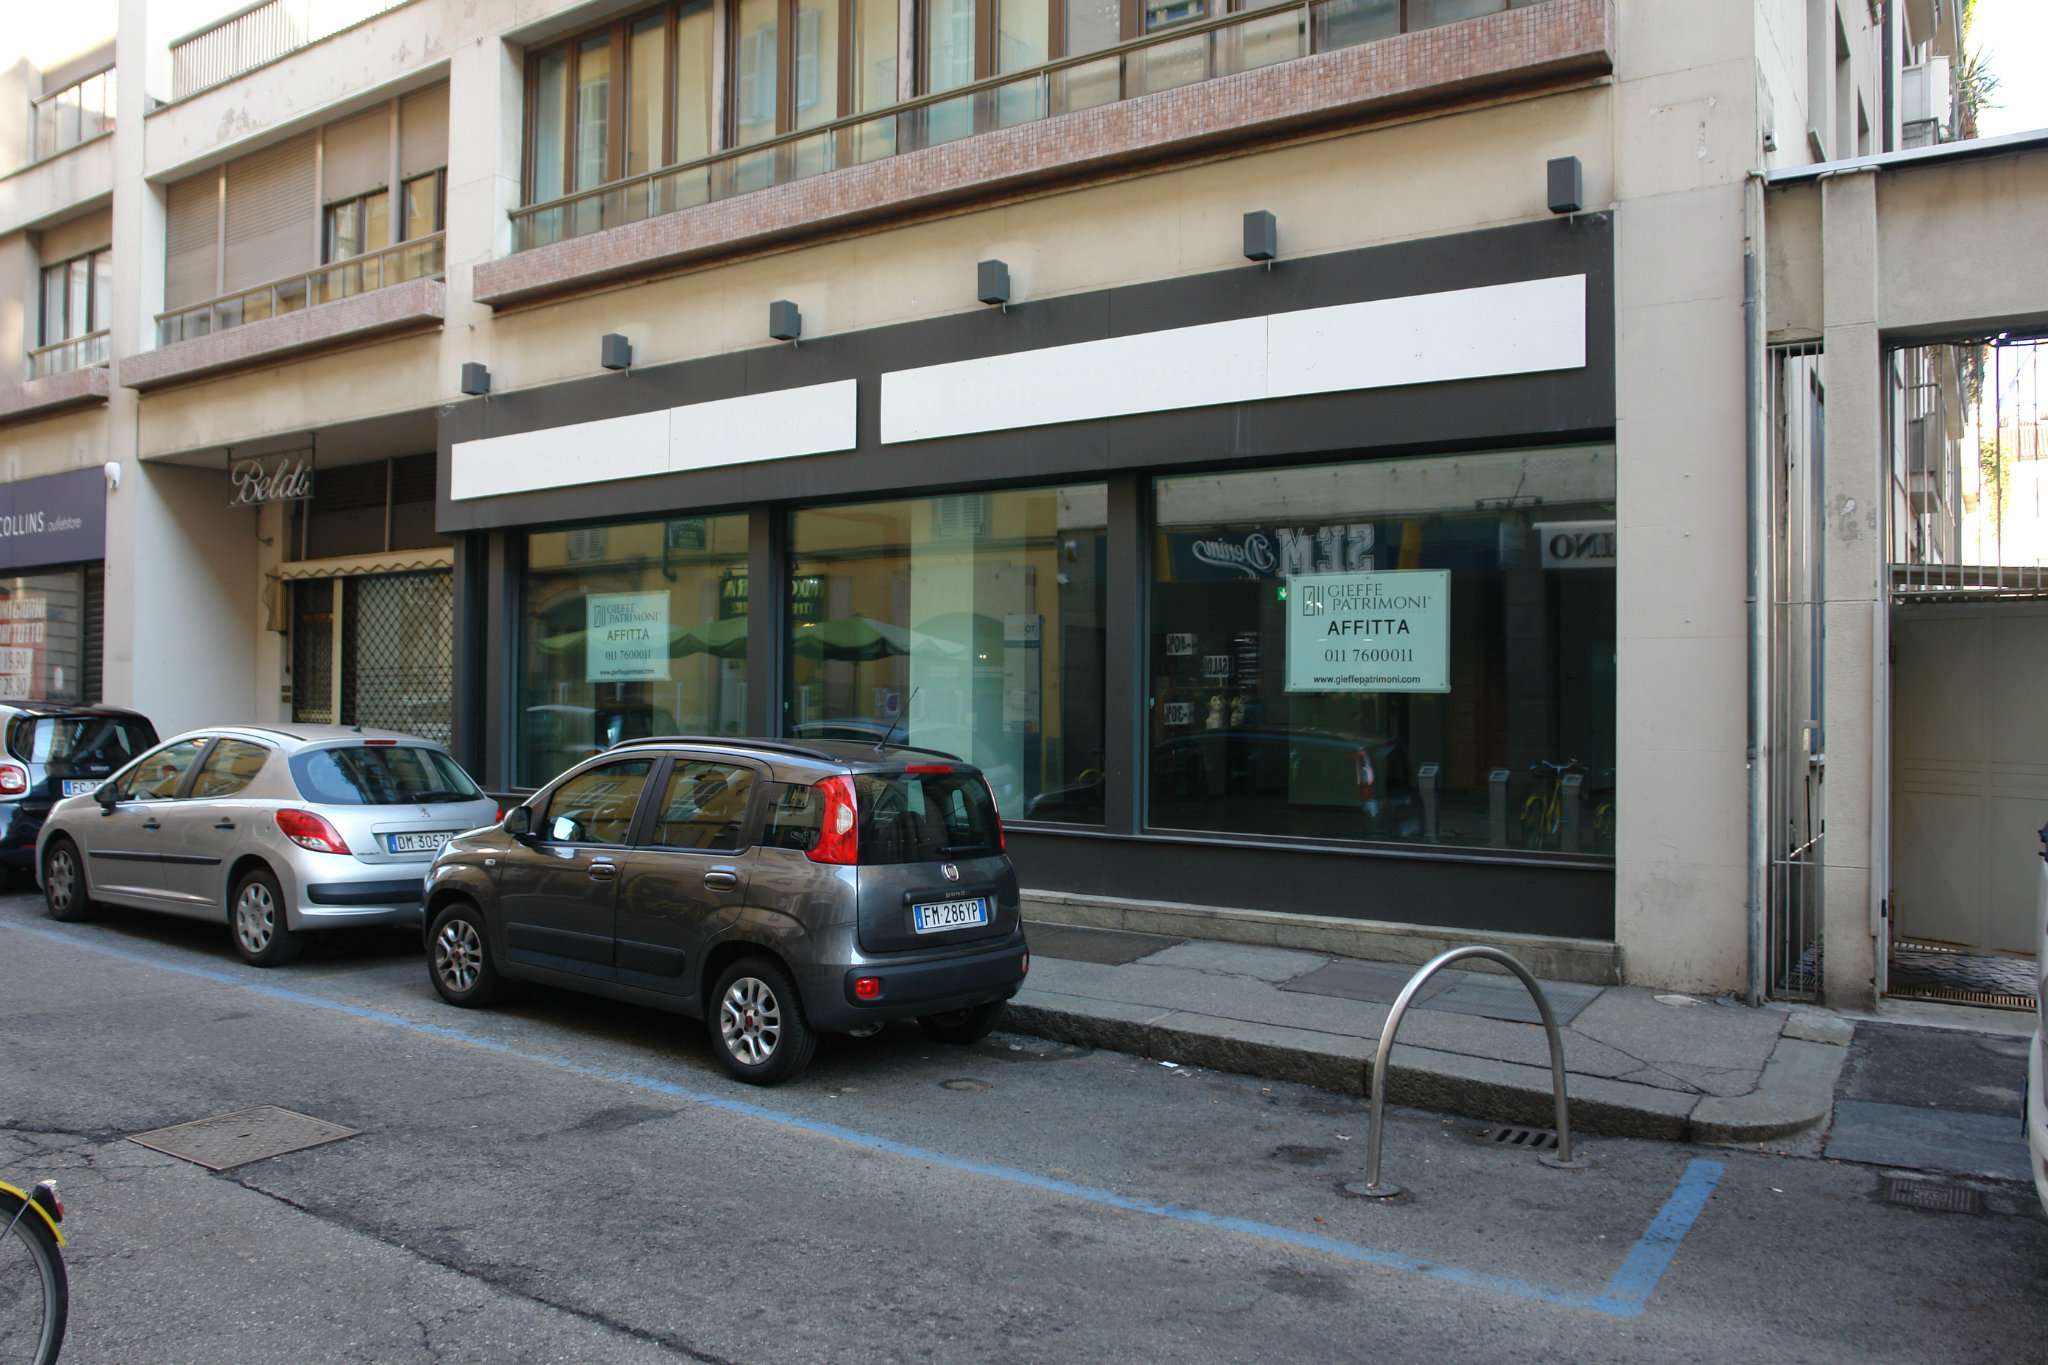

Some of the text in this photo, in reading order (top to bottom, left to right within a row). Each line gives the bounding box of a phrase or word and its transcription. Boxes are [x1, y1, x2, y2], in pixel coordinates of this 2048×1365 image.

[1327, 583, 1383, 597] GIEFFE
[607, 627, 650, 641] AFFITTA
[1327, 619, 1410, 635] AFFITTA
[1324, 649, 1413, 662] 011 7600011
[1313, 674, 1421, 686] www.gieffepatrimoni.com
[397, 835, 414, 850] DM
[923, 902, 978, 927] FM 286YP
